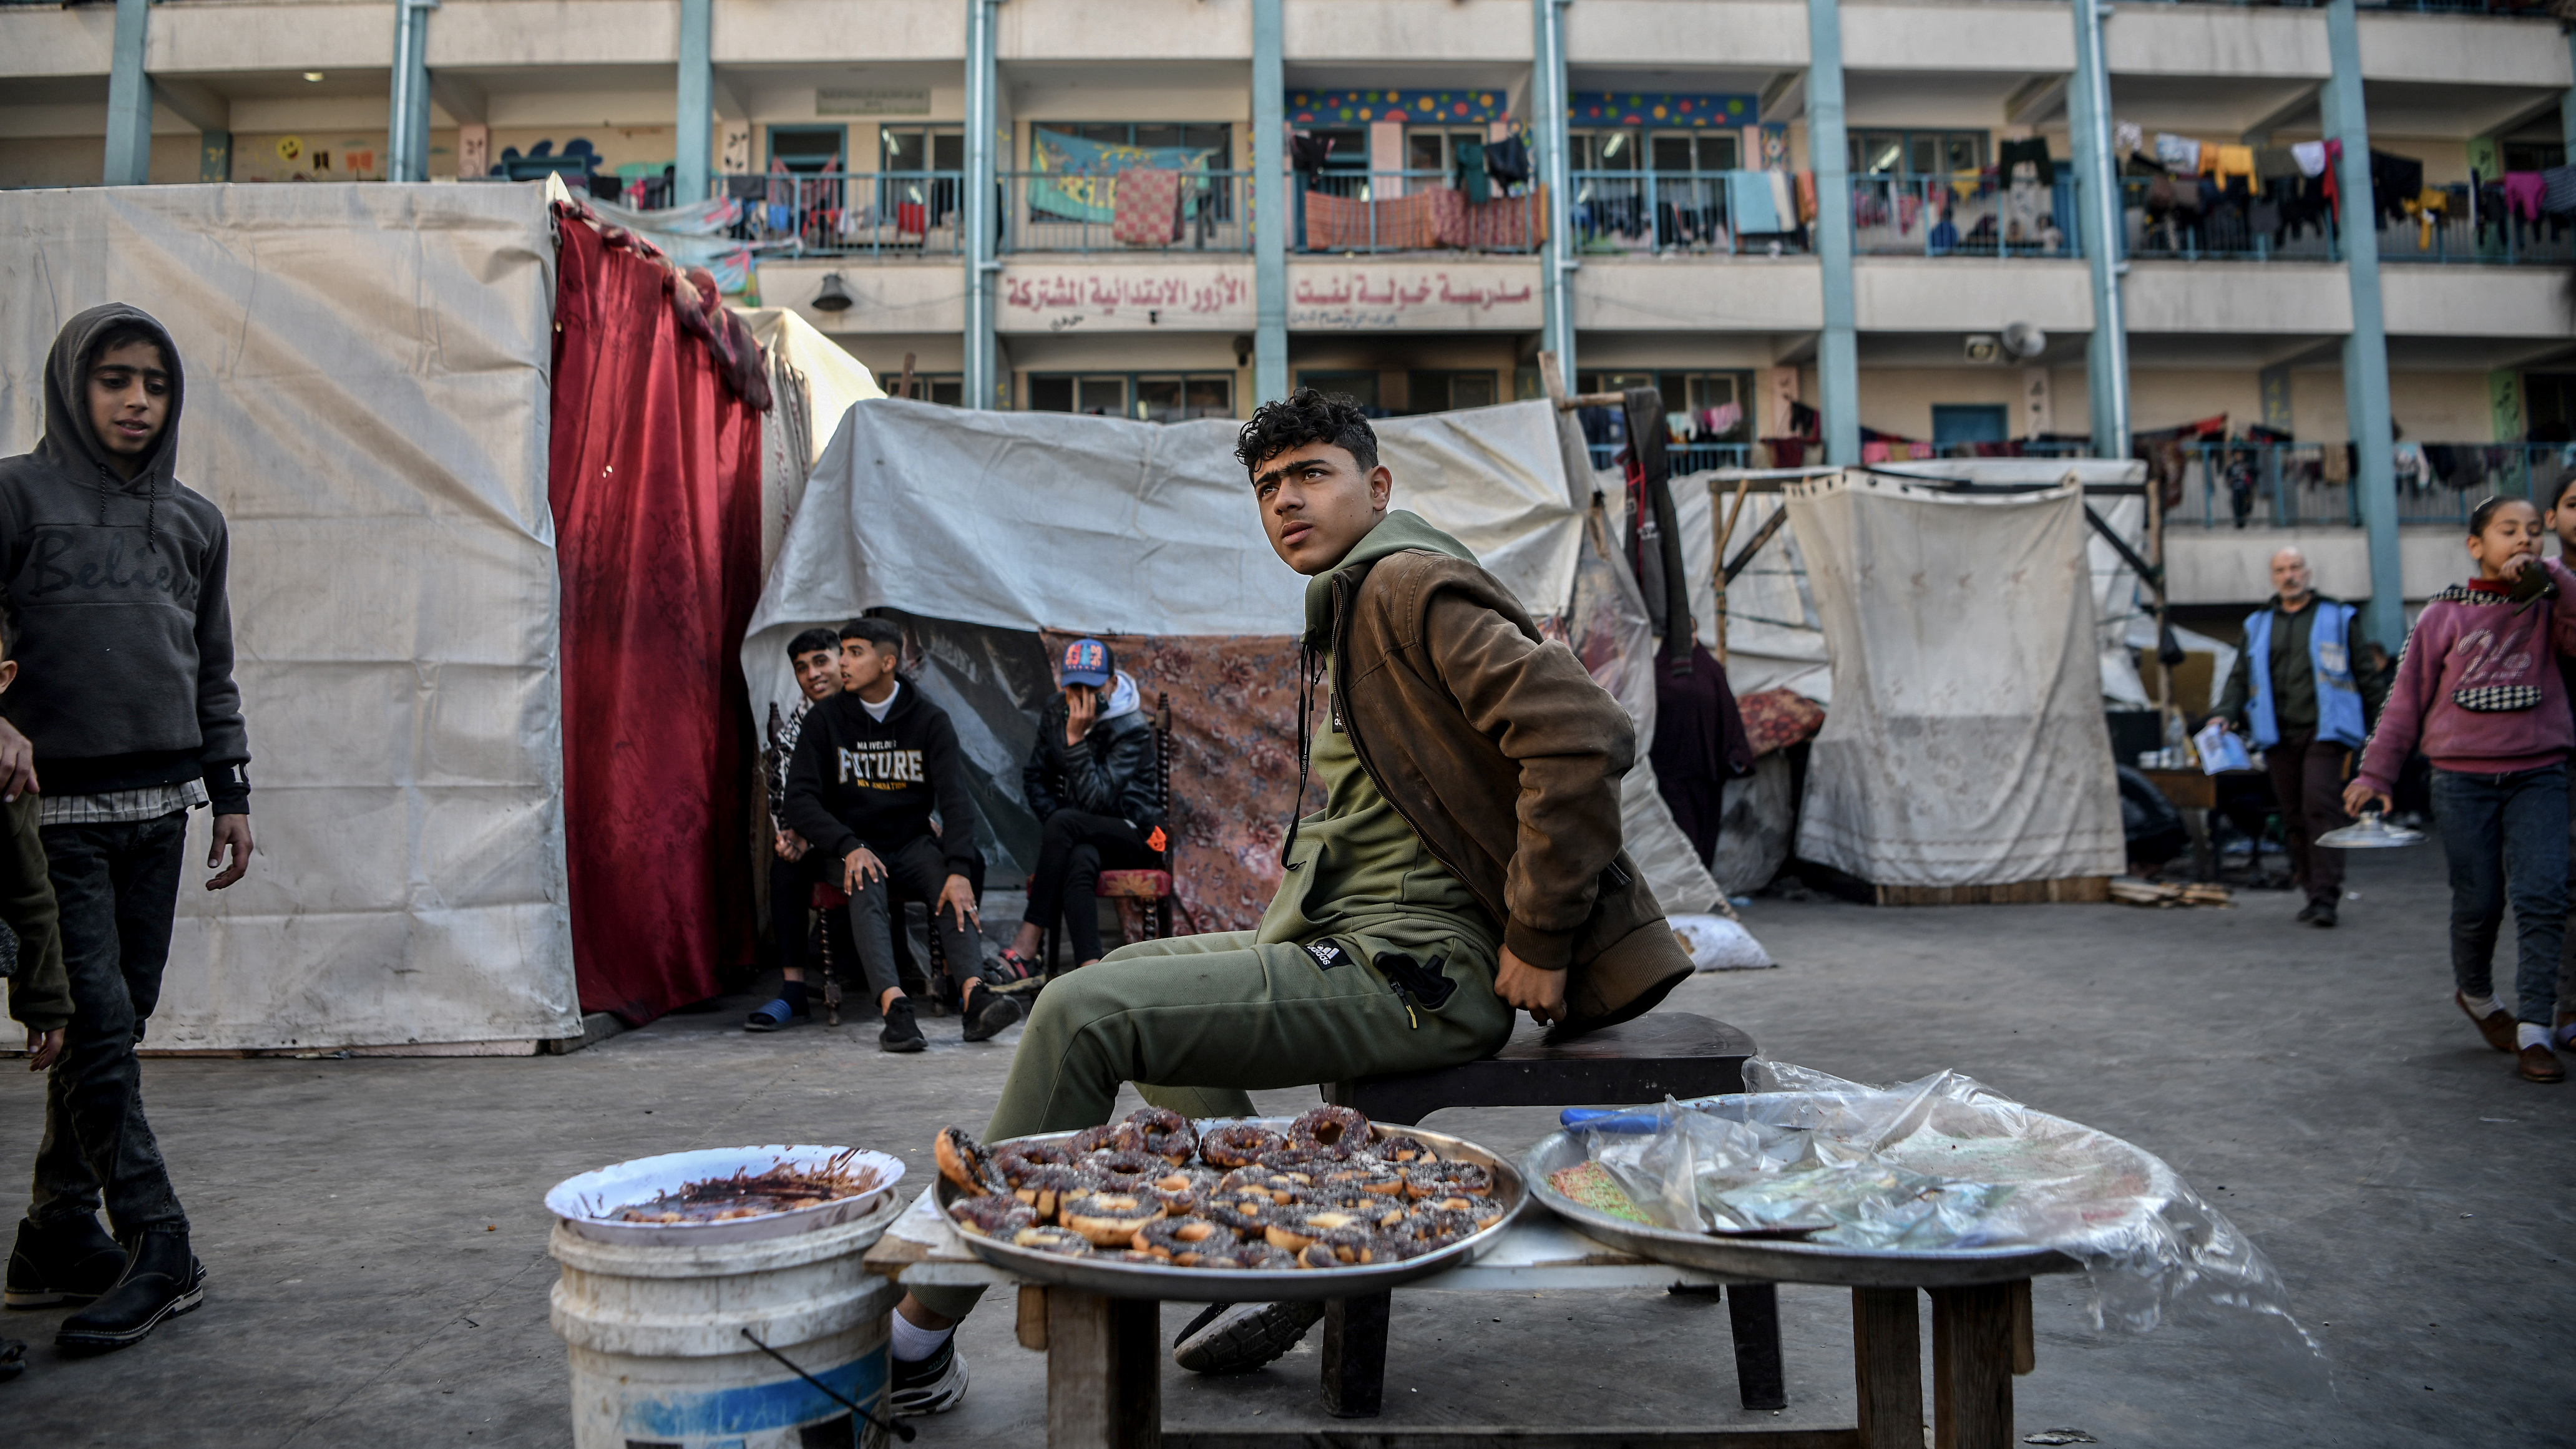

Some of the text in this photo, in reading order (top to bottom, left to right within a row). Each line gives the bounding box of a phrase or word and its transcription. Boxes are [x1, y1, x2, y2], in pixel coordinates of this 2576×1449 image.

[1007, 275, 1084, 313] المشتركة
[1295, 273, 1530, 314] مدرسة خولة بنت
[837, 746, 925, 784] FUTURE
